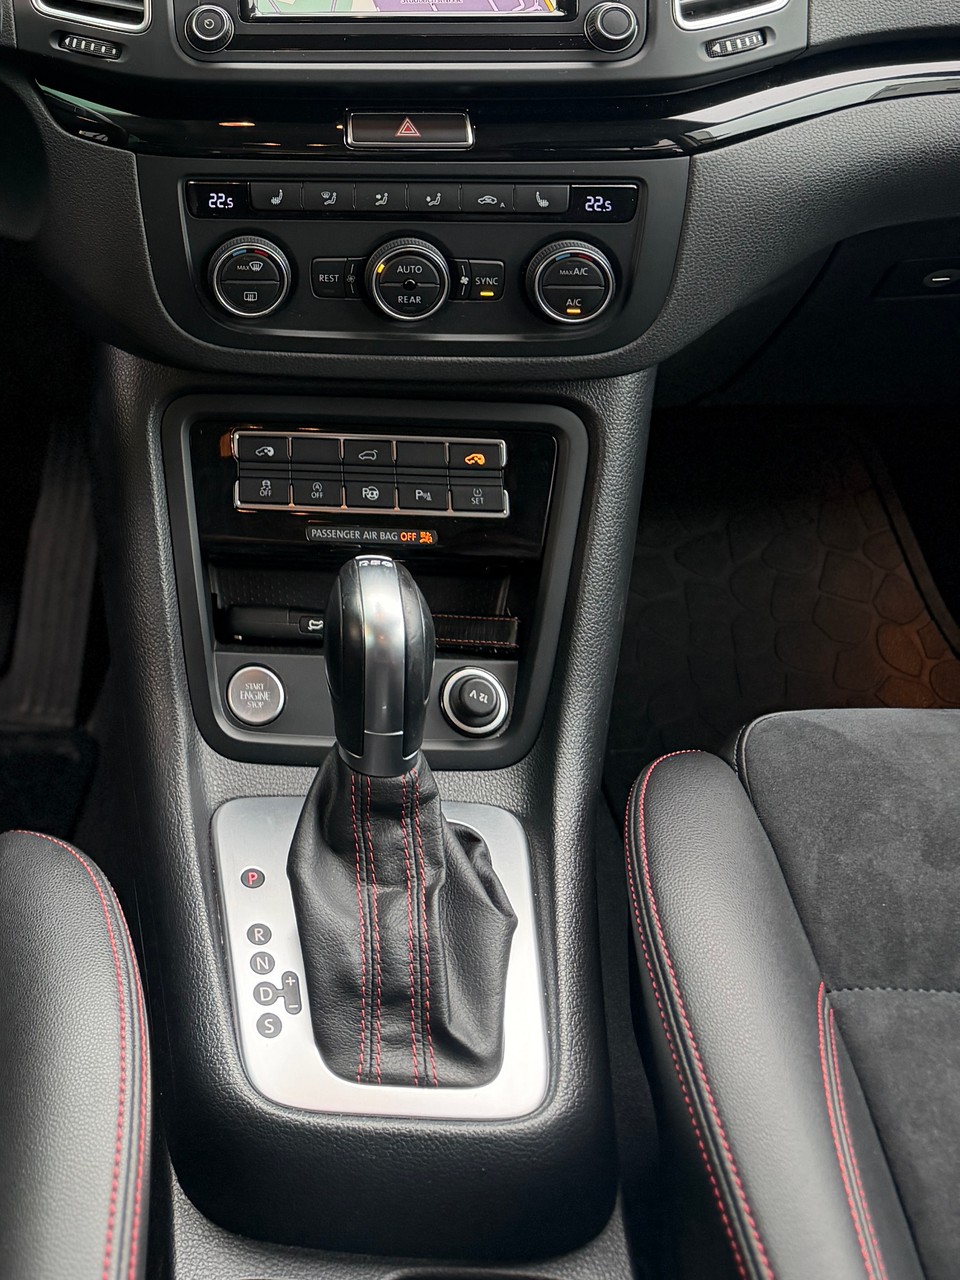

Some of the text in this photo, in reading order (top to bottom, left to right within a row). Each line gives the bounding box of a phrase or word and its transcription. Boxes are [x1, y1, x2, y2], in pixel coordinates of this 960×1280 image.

[208, 193, 234, 209] 22.5
[585, 196, 612, 212] 22.5
[397, 265, 423, 274] AUTO
[573, 267, 589, 276] A/C
[319, 274, 339, 283] REST
[475, 277, 499, 286] SYNC
[398, 295, 422, 304] REAR
[566, 298, 582, 307] A/C
[471, 497, 484, 505] SET
[311, 528, 417, 542] PASSENGER AIR BAG OFF
[240, 690, 271, 701] ENGINE
[247, 701, 264, 709] STOP
[248, 872, 258, 885] P
[254, 928, 264, 941] R
[256, 956, 269, 970] N
[259, 987, 273, 1001] D
[264, 1019, 275, 1033] S
